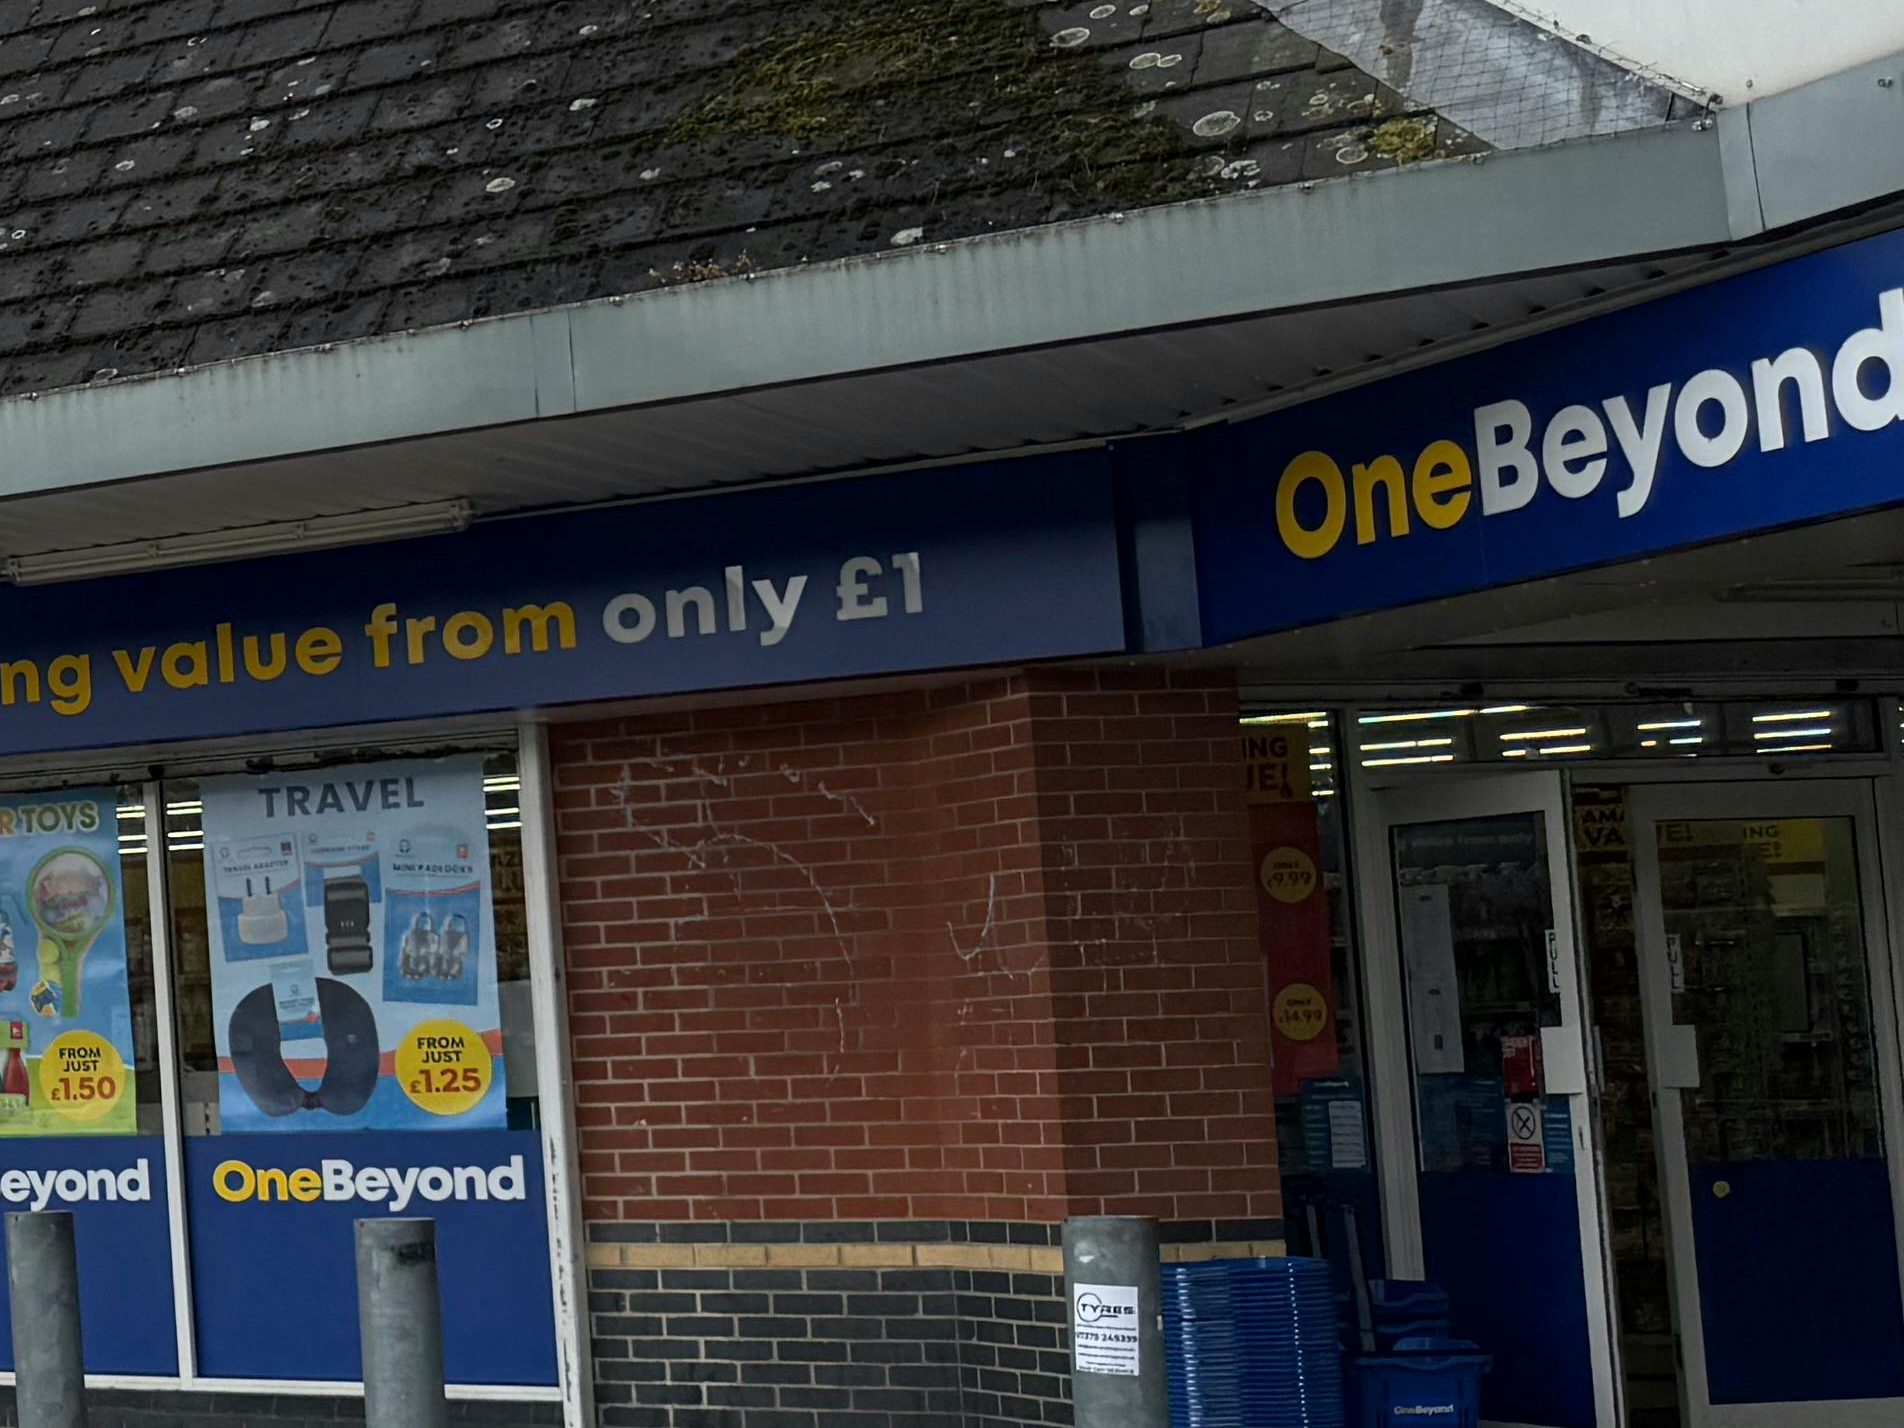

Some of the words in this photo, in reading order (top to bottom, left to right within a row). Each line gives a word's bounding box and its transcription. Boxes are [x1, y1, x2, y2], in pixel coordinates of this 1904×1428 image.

[1275, 288, 1904, 560] OneBeyond
[112, 622, 342, 696] value
[364, 603, 576, 670] from
[601, 565, 808, 648] only
[836, 551, 924, 623] £1
[258, 777, 425, 818] TRAVEL
[18, 801, 99, 836] TOYS
[59, 1047, 101, 1060] FROM
[417, 1036, 465, 1050] FROM
[63, 1059, 98, 1073] JUST
[422, 1050, 463, 1064] JUST
[51, 1076, 116, 1101] £1.50
[410, 1068, 481, 1094] £1.25
[213, 1155, 526, 1211] OneBeyond
[1393, 1403, 1454, 1417] OneBeyond
